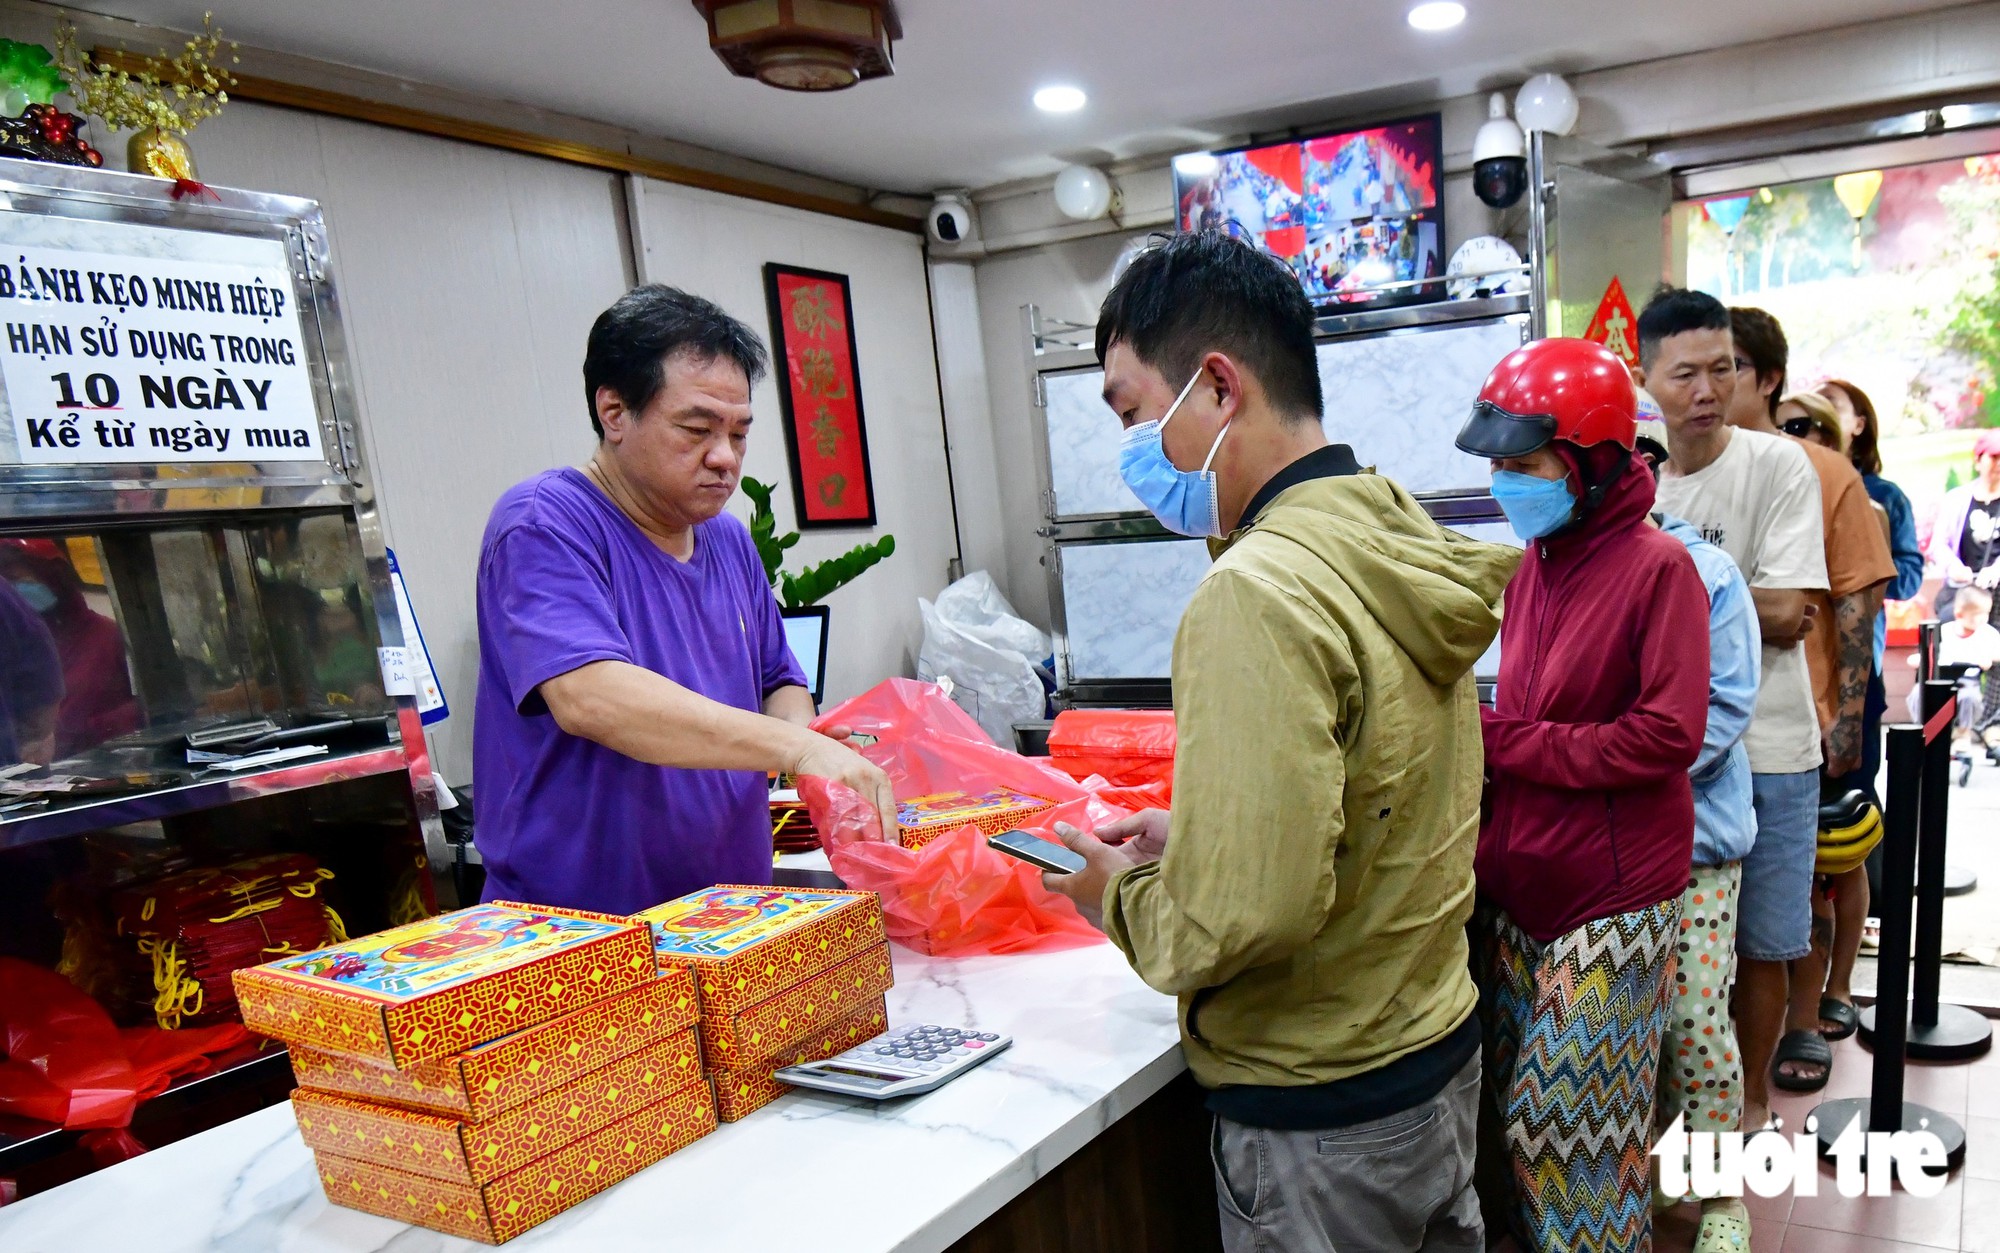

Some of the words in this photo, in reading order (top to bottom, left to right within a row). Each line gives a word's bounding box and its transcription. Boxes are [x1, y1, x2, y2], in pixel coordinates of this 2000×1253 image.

[87, 271, 147, 314] KẸO
[153, 277, 225, 313] MINH
[228, 276, 285, 323] HIỆP
[6, 322, 73, 361] HẠN
[80, 316, 118, 358] SỬ
[128, 329, 206, 365] DỤNG
[210, 334, 296, 366] TRONG
[51, 372, 120, 408] 10
[140, 368, 272, 411] NGÀY
[26, 412, 80, 448] Kể
[94, 419, 136, 448] từ
[149, 420, 230, 453] ngày
[245, 428, 311, 448] mua
